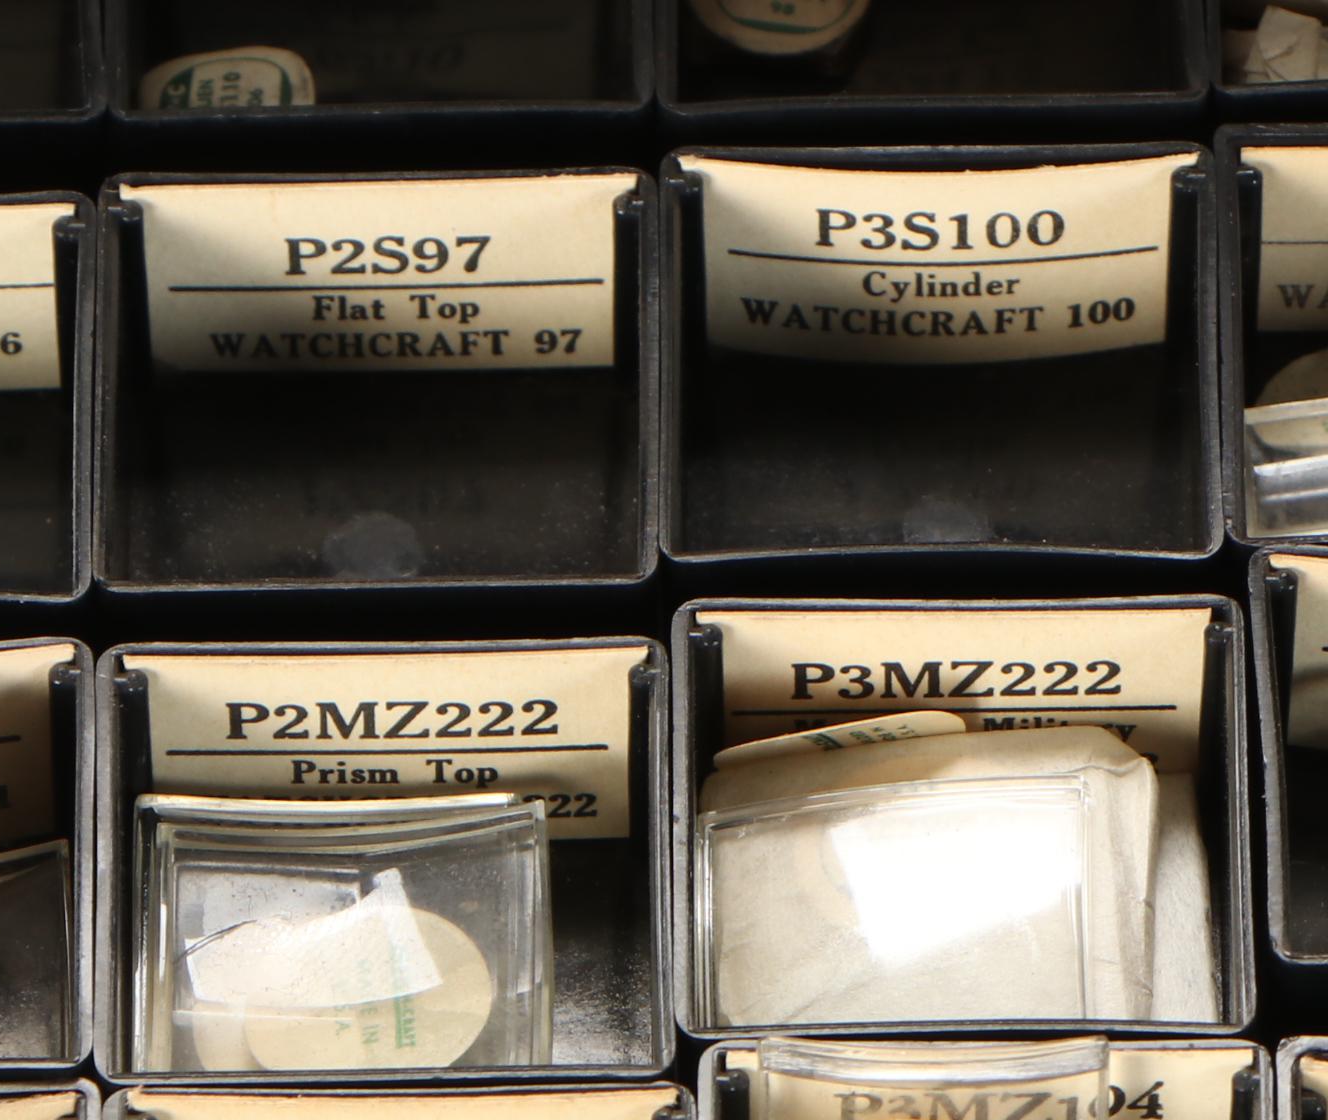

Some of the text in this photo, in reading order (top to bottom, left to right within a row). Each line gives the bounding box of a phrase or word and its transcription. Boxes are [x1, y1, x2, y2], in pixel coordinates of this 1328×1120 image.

[815, 208, 1065, 251] P3S100
[284, 235, 492, 275] P2S97
[861, 271, 1021, 303] Cylinder
[312, 294, 480, 324] Flat Top
[739, 297, 1136, 337] WATCHCRAFT 100
[209, 328, 583, 360] WATCHCRAFT 97
[790, 660, 1123, 700] P3MZ222
[225, 699, 560, 740] P2MZ222
[290, 758, 499, 789] Prism Top
